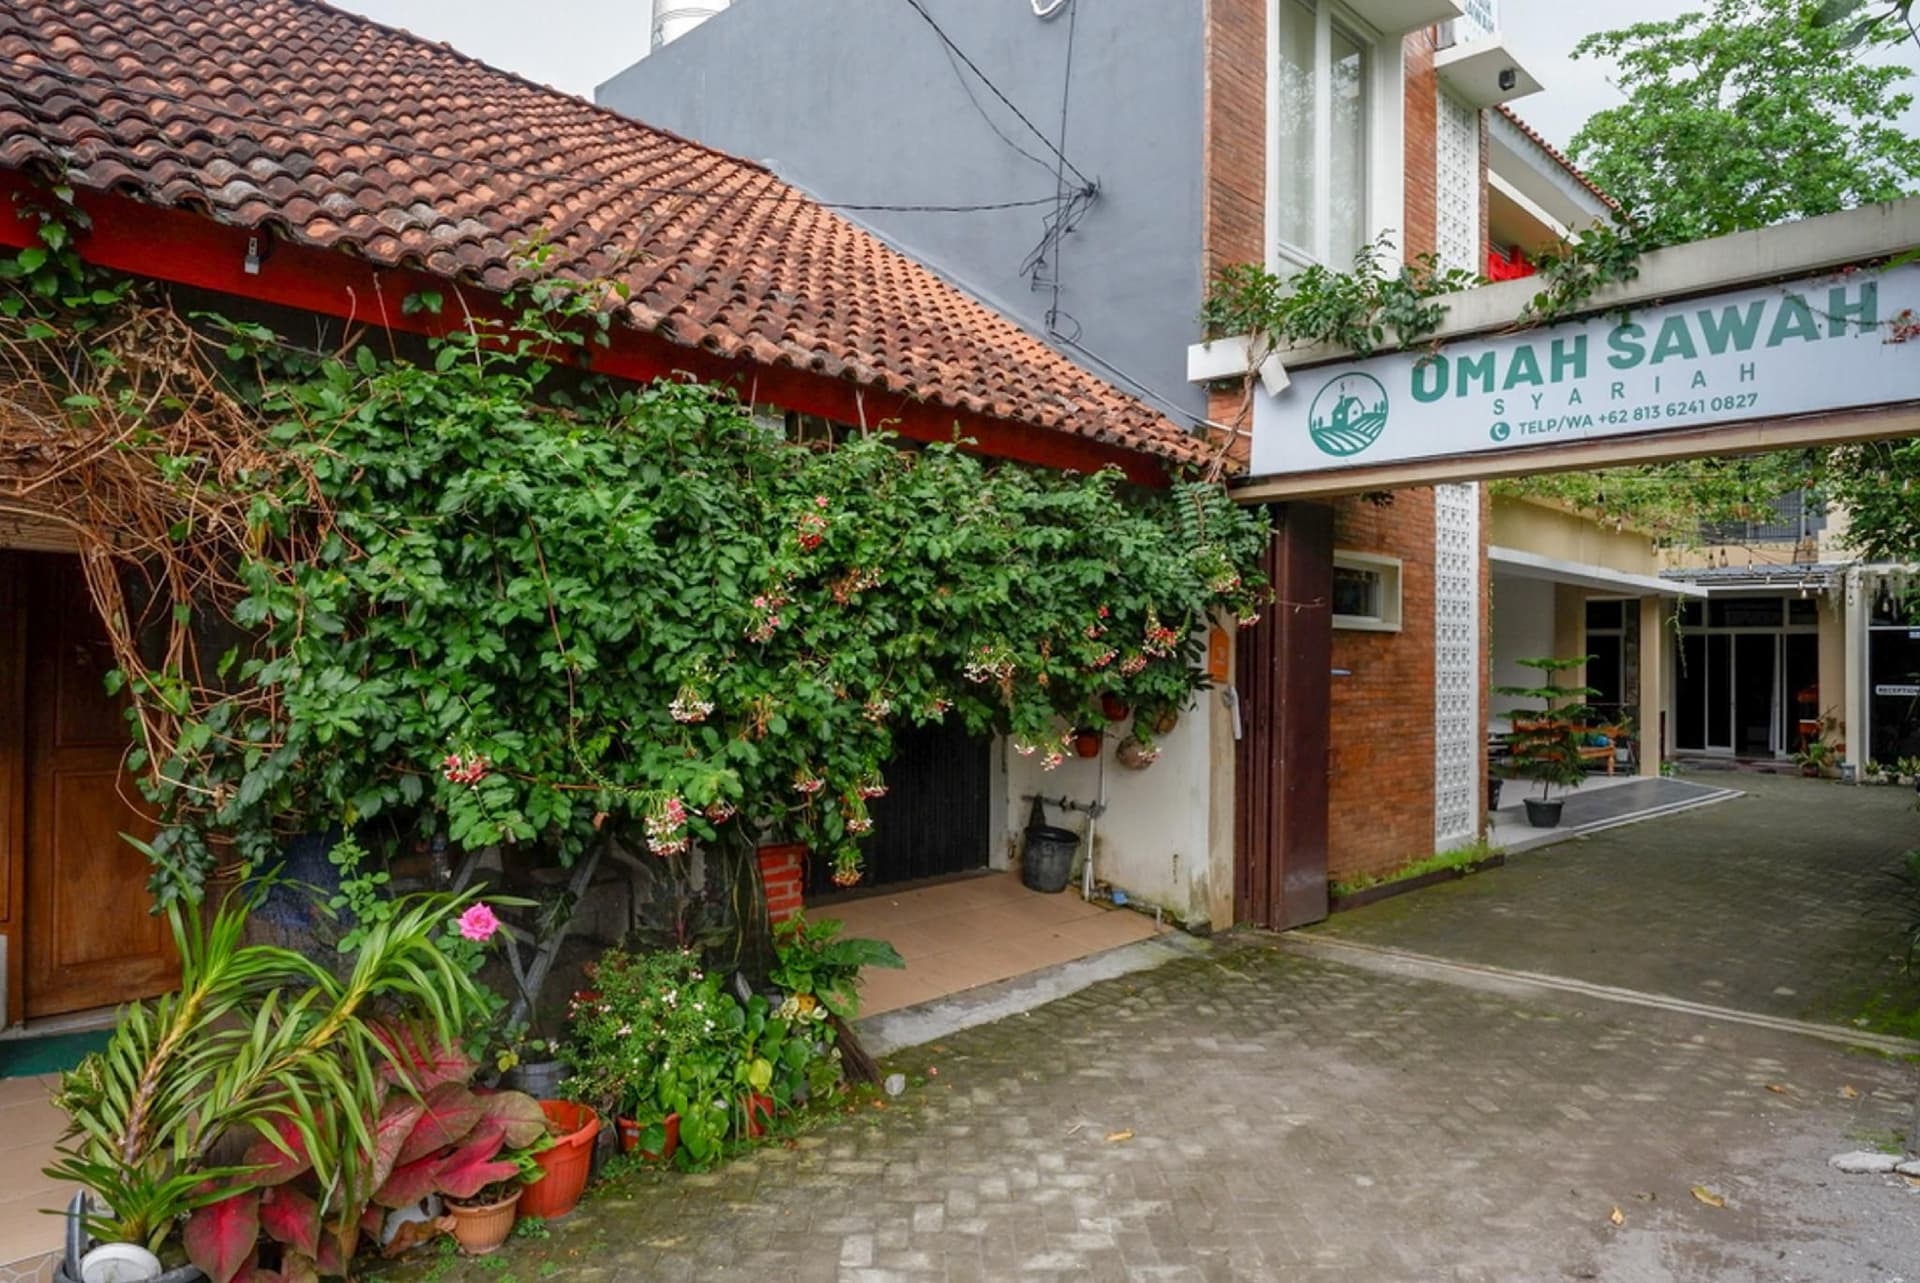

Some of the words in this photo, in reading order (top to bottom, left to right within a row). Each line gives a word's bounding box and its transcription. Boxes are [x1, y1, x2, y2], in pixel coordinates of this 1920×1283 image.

[1411, 334, 1588, 404] OMAH
[1607, 281, 1878, 370] SAWAH
[1493, 362, 1756, 416] SYARIAH
[1518, 413, 1593, 436] TELP/WA
[1599, 409, 1628, 425] +62
[1633, 404, 1661, 421] 813
[1666, 398, 1705, 417] 6241
[1711, 392, 1759, 412] 0827
